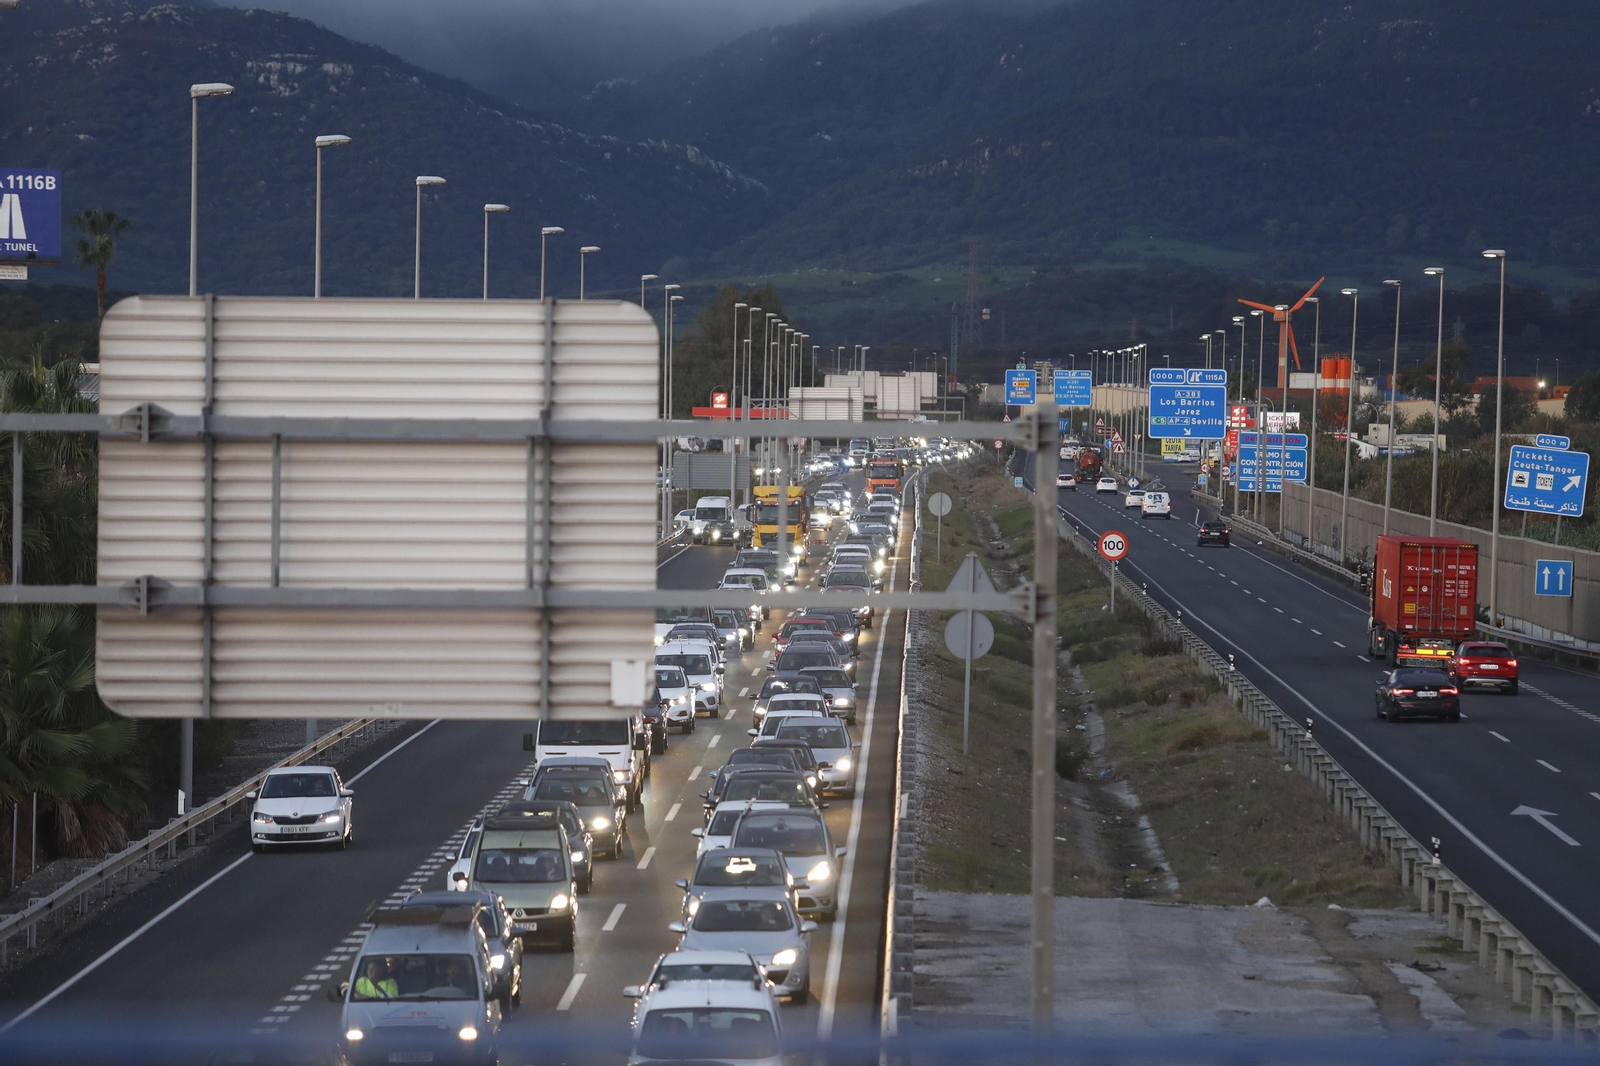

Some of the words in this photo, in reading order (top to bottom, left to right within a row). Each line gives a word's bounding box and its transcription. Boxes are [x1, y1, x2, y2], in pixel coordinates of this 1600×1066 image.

[7, 174, 56, 190] 1116B
[4, 242, 38, 252] TUNEL
[1516, 451, 1553, 461] Tickets
[1241, 459, 1303, 468] CONNTRCIÓN
[1514, 461, 1576, 475] Ceuta-Tanger
[1103, 540, 1124, 551] 100
